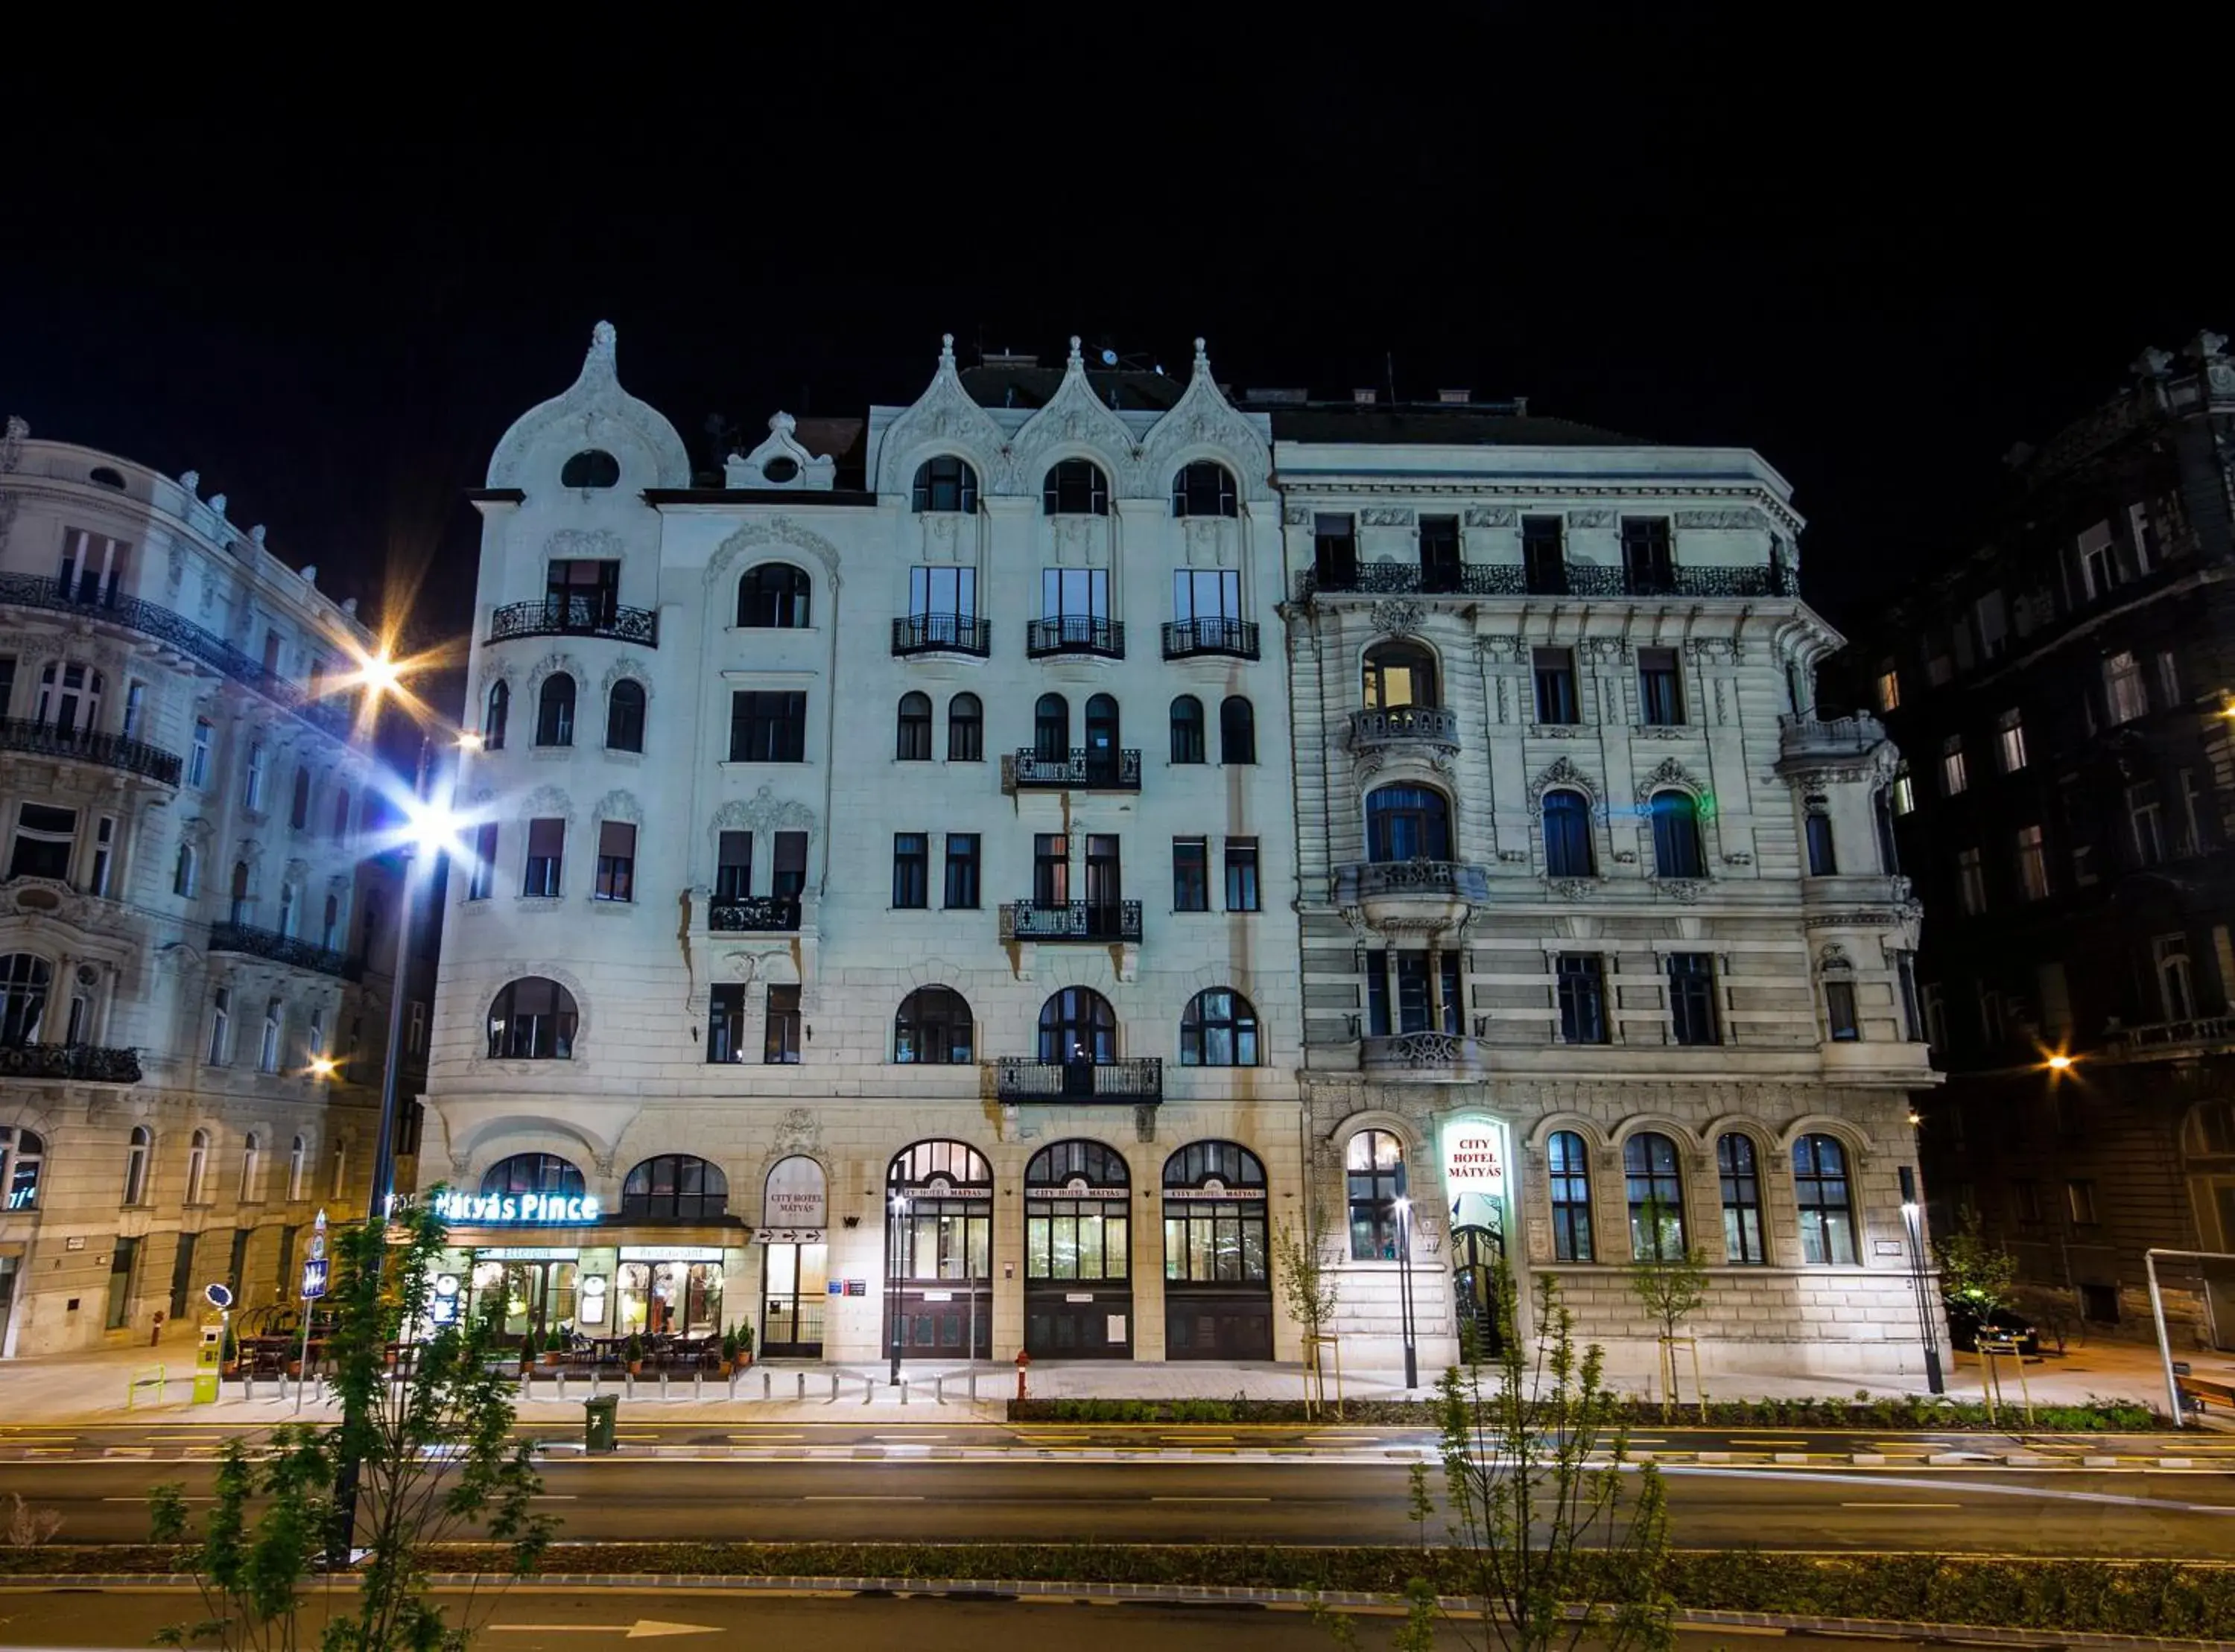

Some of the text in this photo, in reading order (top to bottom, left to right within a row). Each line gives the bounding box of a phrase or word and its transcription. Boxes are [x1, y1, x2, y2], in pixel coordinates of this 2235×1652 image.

[1459, 1139, 1490, 1149] CITY
[1453, 1153, 1497, 1163] HOTEL
[1448, 1165, 1501, 1178] MÁTYÁS
[771, 1194, 822, 1202] CITY HOTEL
[522, 1194, 599, 1220] Pince
[592, 1415, 601, 1430] 7
